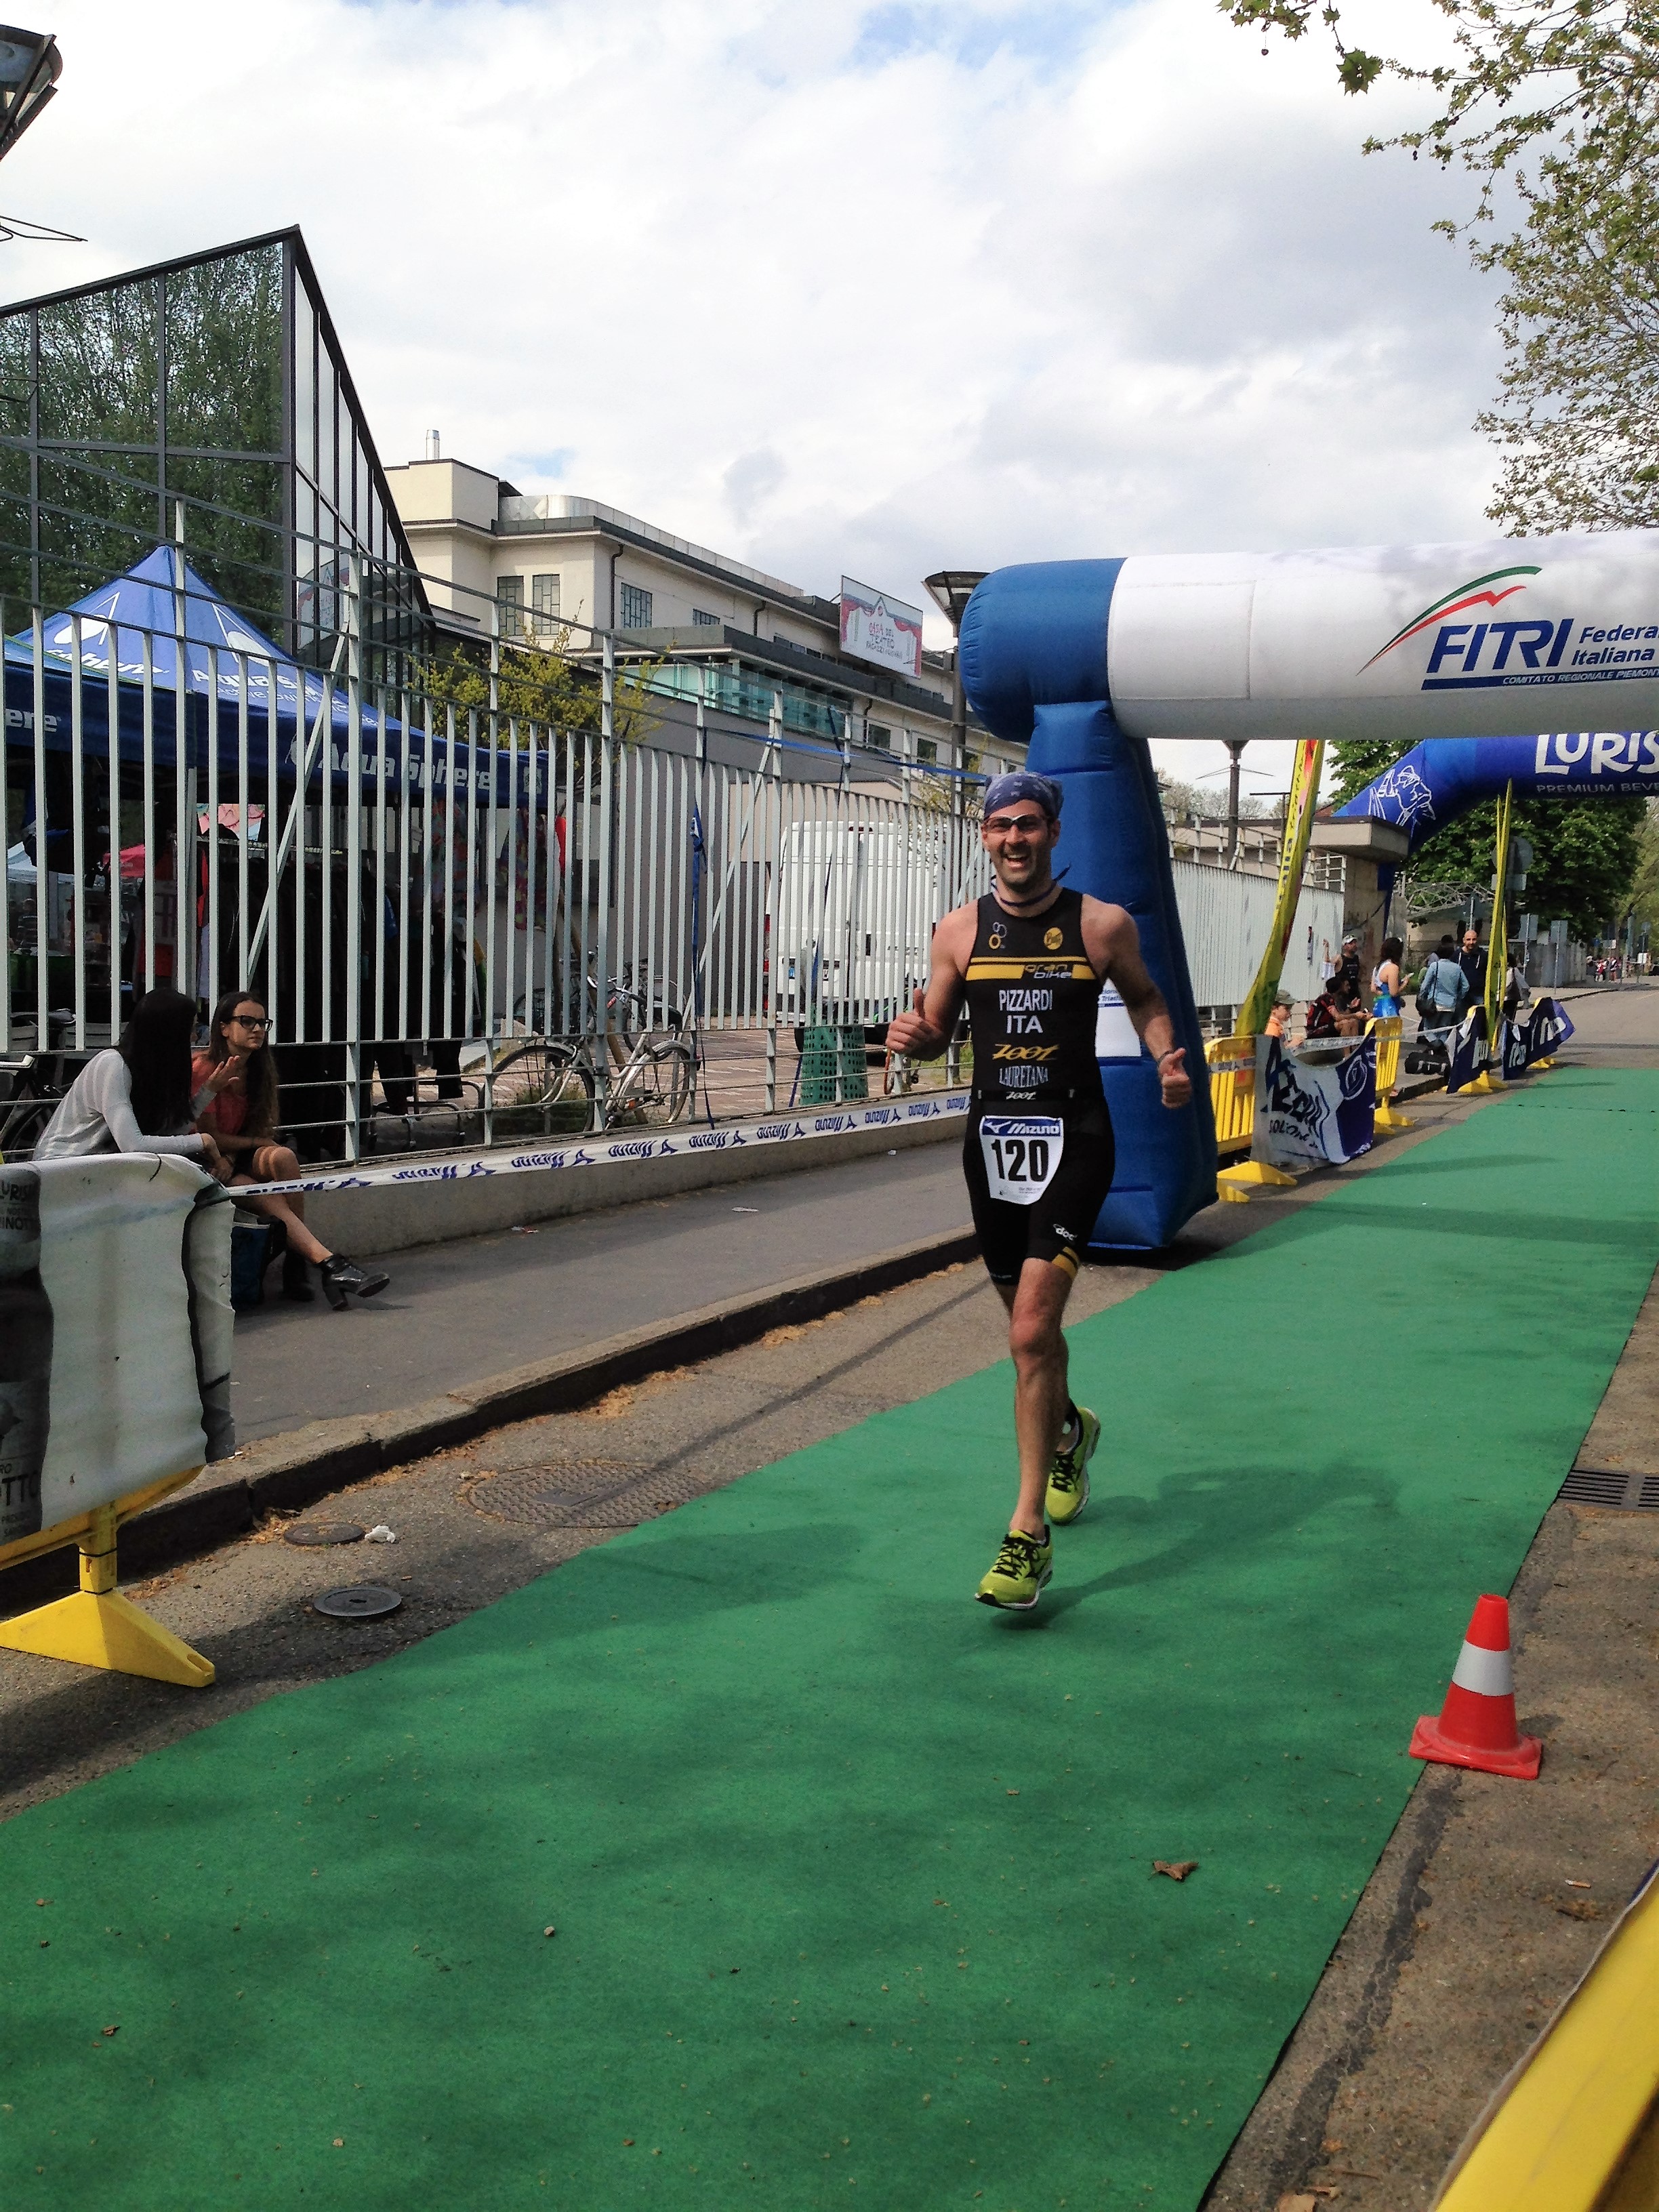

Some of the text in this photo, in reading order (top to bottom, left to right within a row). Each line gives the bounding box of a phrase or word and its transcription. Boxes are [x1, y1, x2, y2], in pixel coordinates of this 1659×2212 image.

[1578, 624, 1659, 644] Federa
[1426, 618, 1574, 674] FITRI
[1571, 647, 1656, 665] Italiana
[1502, 674, 1555, 684] COMITATO
[1557, 671, 1614, 682] REGIONALE
[1536, 783, 1615, 793] PREMIUM
[998, 989, 1053, 1012] PIZZARDI
[1006, 1015, 1044, 1034] ITA
[991, 1139, 1049, 1182] 120
